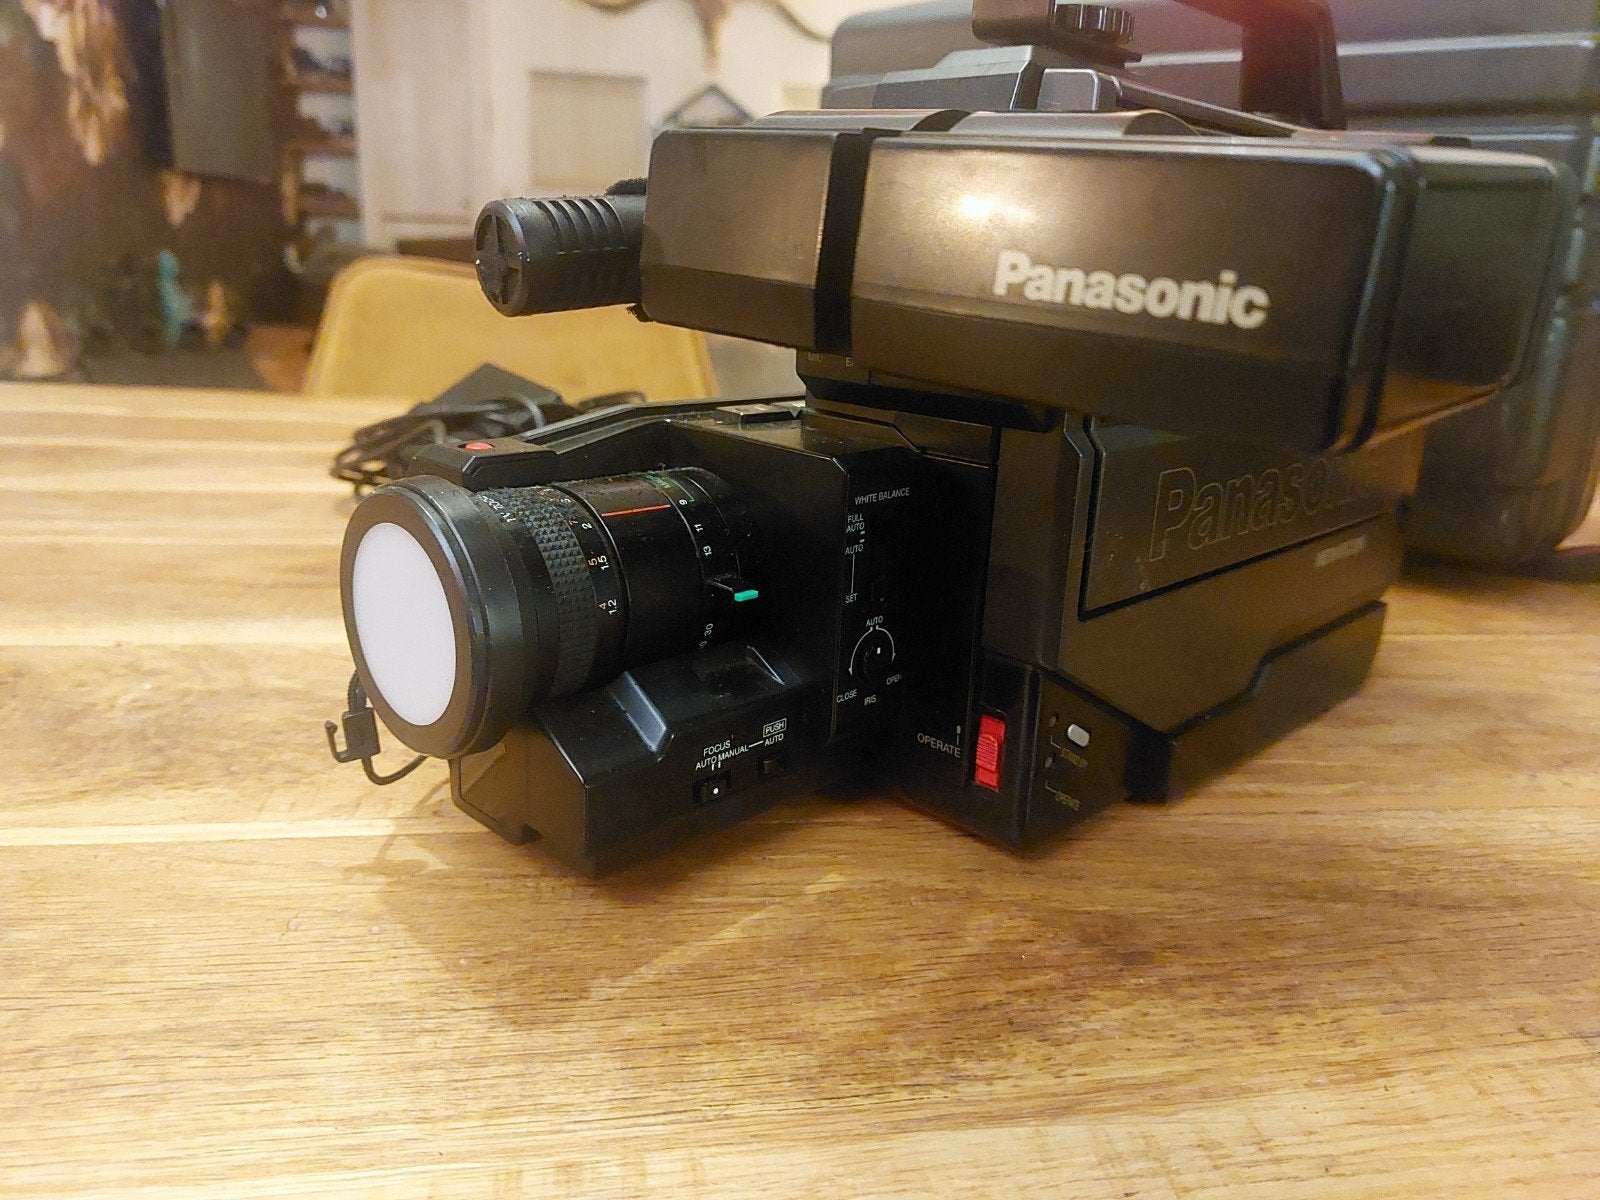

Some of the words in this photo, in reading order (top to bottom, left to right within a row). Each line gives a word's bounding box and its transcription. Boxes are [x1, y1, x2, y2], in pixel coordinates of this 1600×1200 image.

[993, 248, 1271, 330] Panasonic
[855, 493, 877, 505] WHITE
[878, 487, 911, 502] BALANCE
[847, 512, 864, 523] FULL
[581, 522, 593, 531] 2
[694, 523, 704, 533] 11
[846, 521, 865, 533] AUTO
[702, 545, 713, 557] 13
[844, 544, 864, 555] AUTO
[588, 557, 598, 566] 5
[597, 555, 609, 571] 1.5
[845, 593, 858, 604] SET
[598, 601, 607, 610] 4
[608, 599, 618, 615] 1.2
[865, 616, 884, 627] AUTO
[703, 622, 714, 636] 30
[836, 689, 858, 703] CLOSE
[864, 695, 877, 706] IRIS
[765, 721, 785, 735] PUSH
[764, 733, 784, 746] AUTO
[917, 732, 961, 758] OPERATE
[703, 740, 731, 757] FOCUS
[695, 755, 717, 771] AUTO
[717, 744, 749, 762] MANUAL
